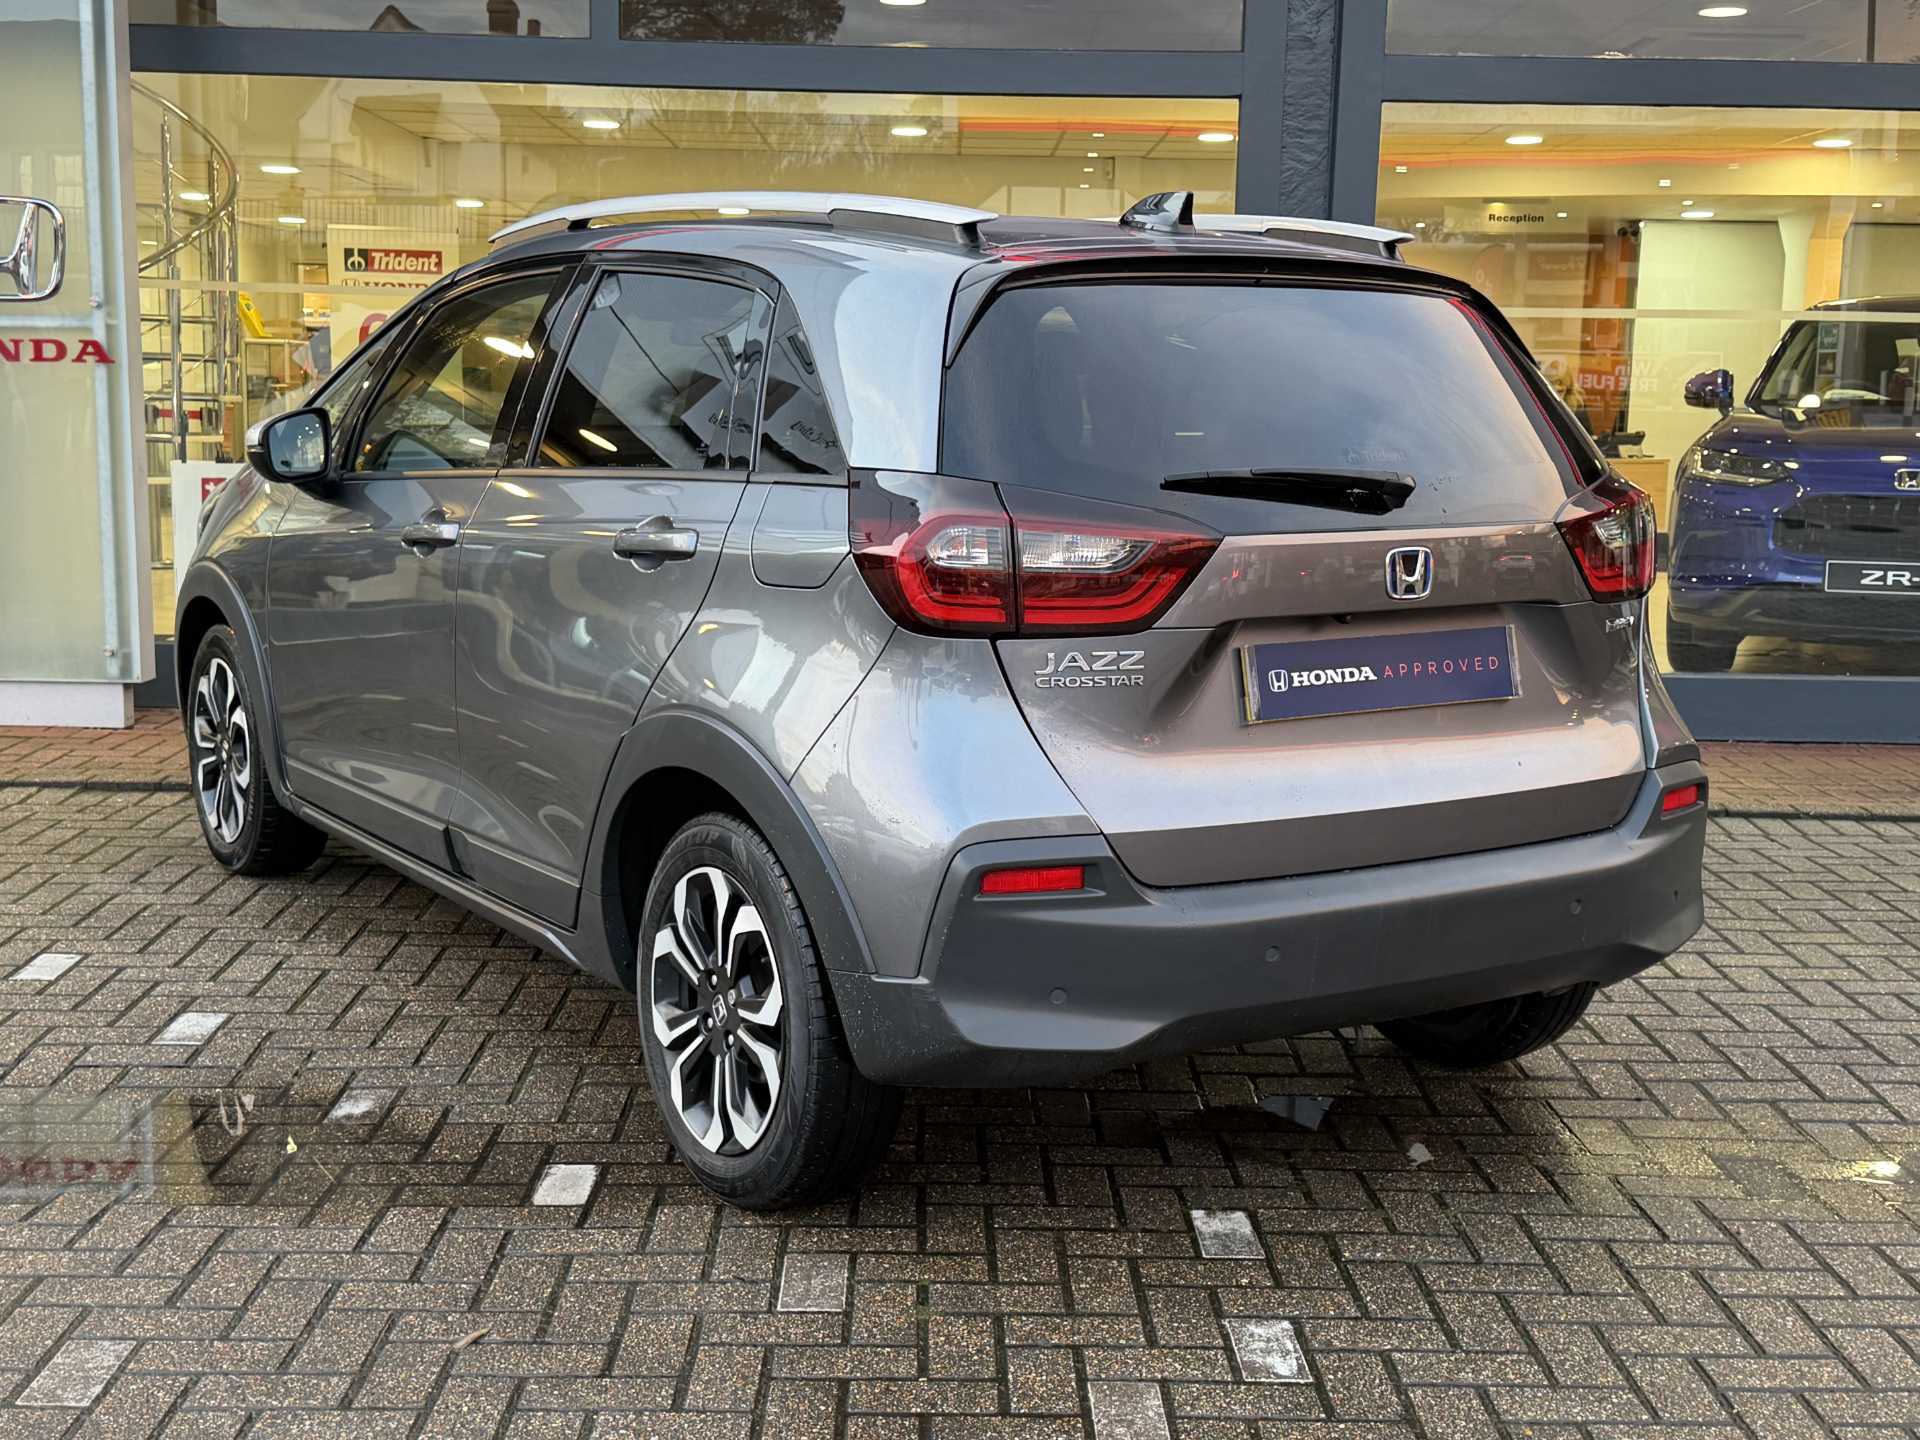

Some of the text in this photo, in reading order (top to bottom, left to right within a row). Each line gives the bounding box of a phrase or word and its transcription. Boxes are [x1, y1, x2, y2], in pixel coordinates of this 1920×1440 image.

[1488, 213, 1545, 224] Reception
[371, 252, 439, 272] Trident
[1035, 650, 1145, 675] JAZZ
[1290, 666, 1378, 688] HONDA
[1383, 656, 1499, 679] APPROVED
[1035, 675, 1145, 688] CROSSTAR
